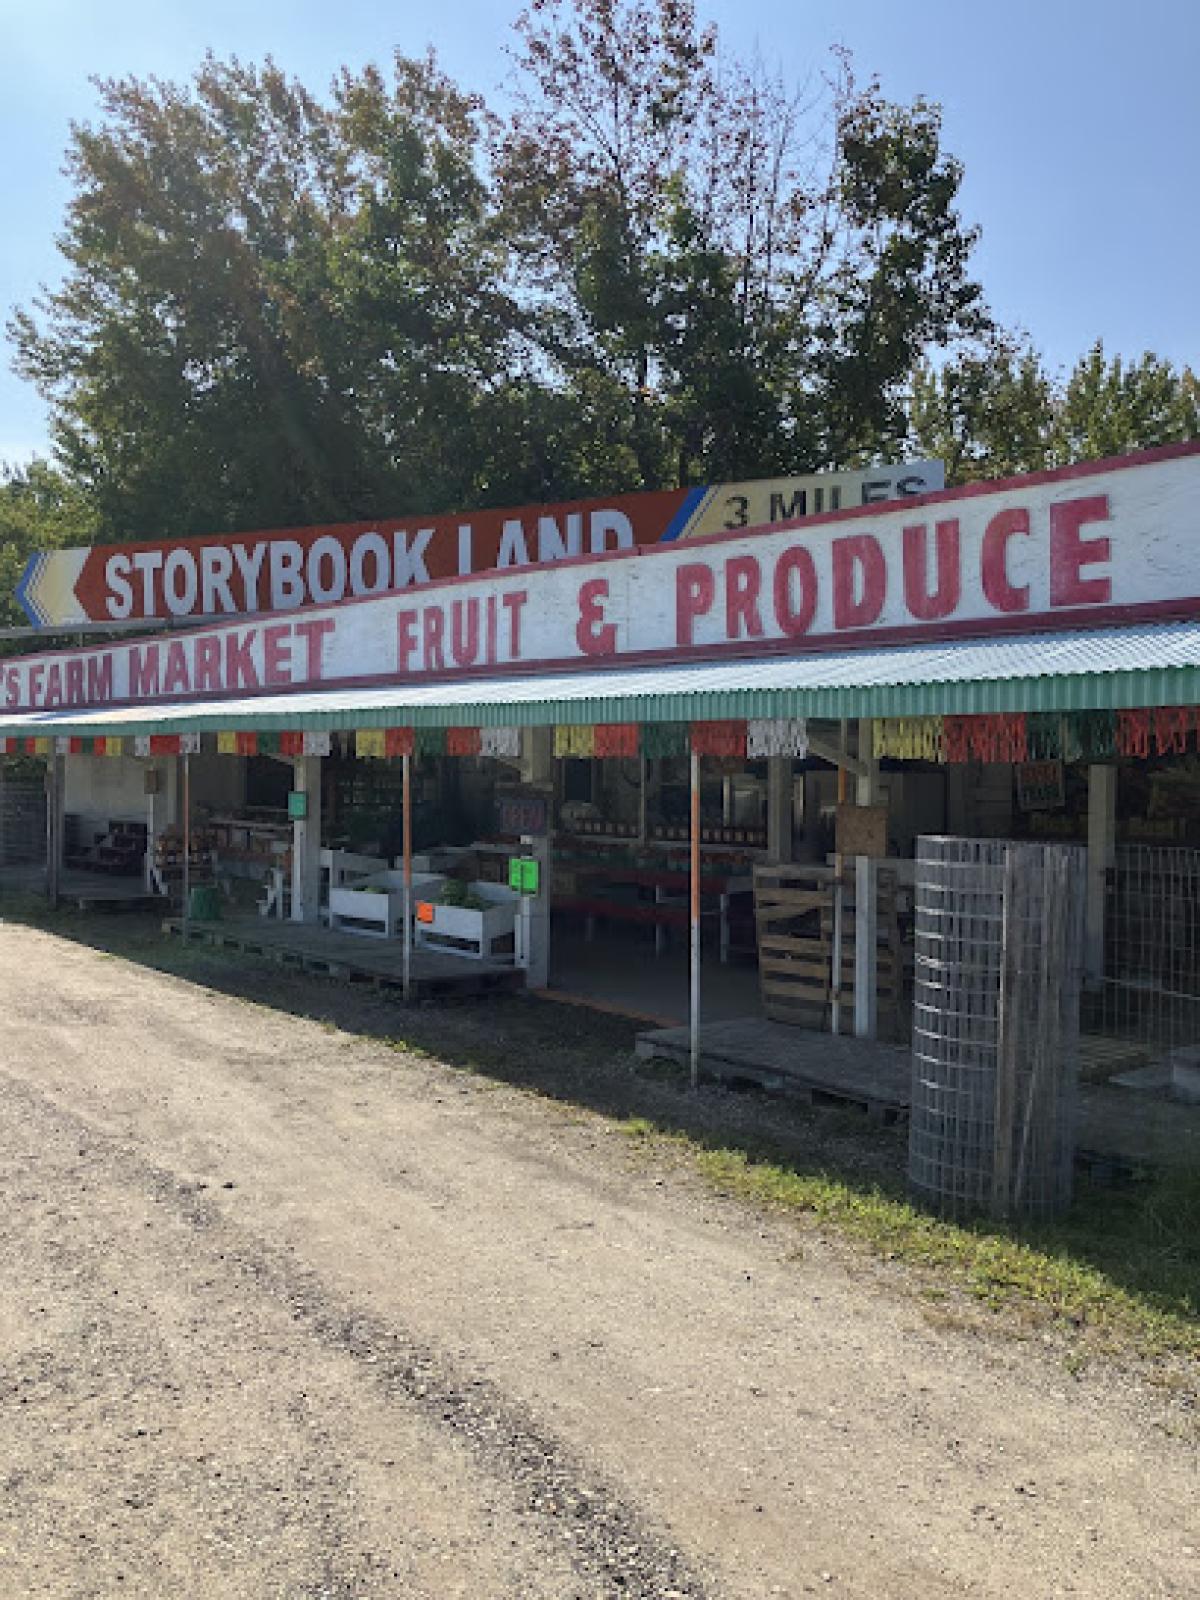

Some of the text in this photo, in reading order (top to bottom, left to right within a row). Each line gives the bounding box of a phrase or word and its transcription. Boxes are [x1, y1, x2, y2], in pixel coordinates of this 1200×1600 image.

[29, 652, 112, 708] FARM
[128, 617, 336, 698] MARKET
[397, 590, 527, 672] FRUIT
[575, 578, 618, 656] &
[675, 494, 1111, 647] PRODUCE
[105, 528, 436, 619] STORYBOOK
[724, 497, 748, 529] 3
